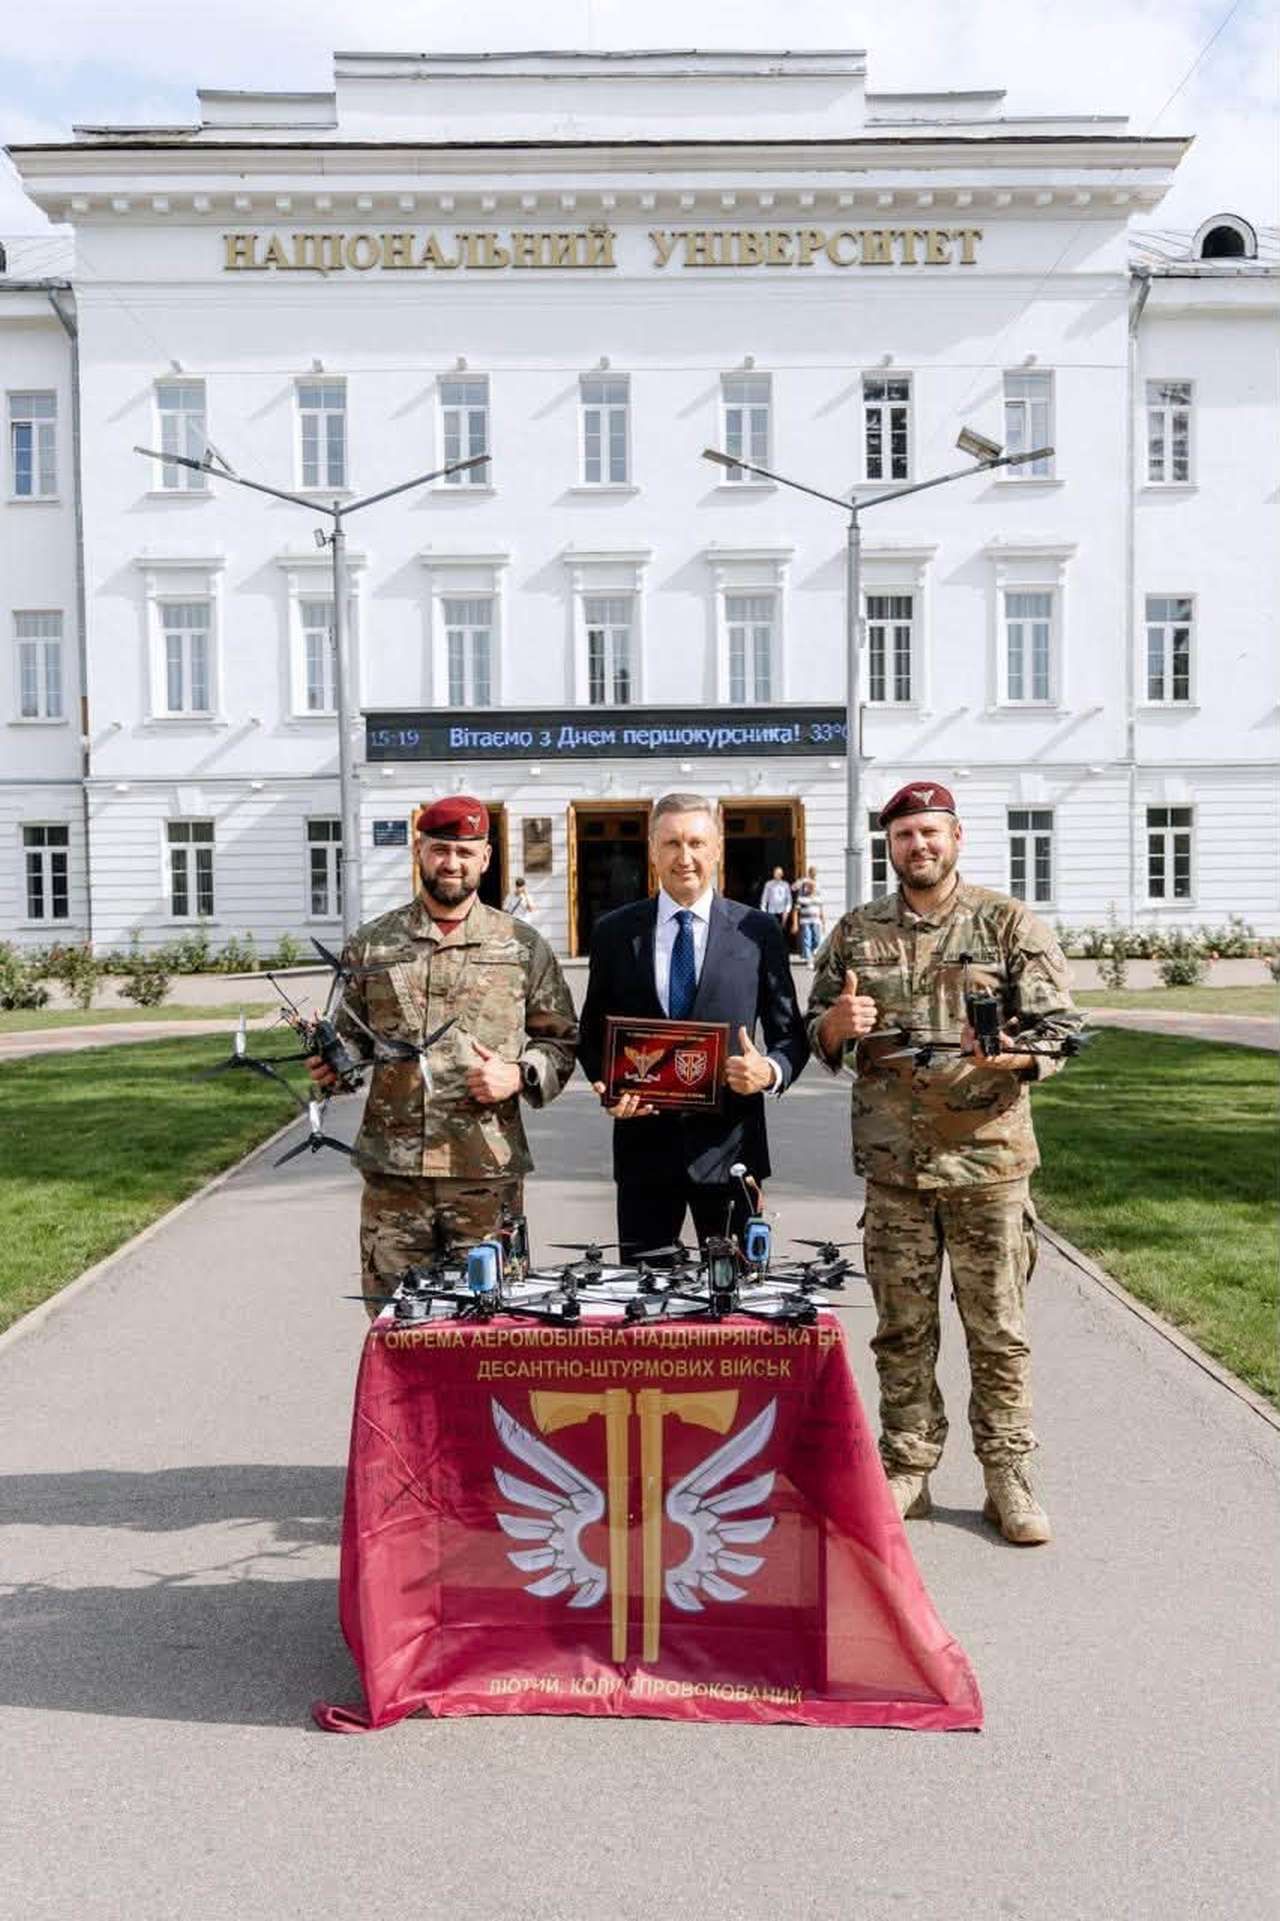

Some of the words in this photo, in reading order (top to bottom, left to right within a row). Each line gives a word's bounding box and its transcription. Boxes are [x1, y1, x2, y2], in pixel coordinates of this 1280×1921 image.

[222, 222, 618, 277] НАЦІОНАЛЬНИЙ
[648, 229, 984, 267] УНІВЕРСИТЕТ
[450, 727, 532, 747] Вітаємо
[538, 733, 550, 747] з
[557, 726, 616, 749] Днем
[623, 723, 800, 749] першокурсника!
[385, 1329, 466, 1349] ОКРЕМА
[471, 1328, 627, 1349] АЕРОМОБІЛЬНА
[633, 1327, 810, 1350] НАДДНІПРЯНСЬКА
[477, 1358, 714, 1381] ДЕСАНТНО-ШТУРМОВИХ
[720, 1356, 791, 1377] ВІЙСЬК
